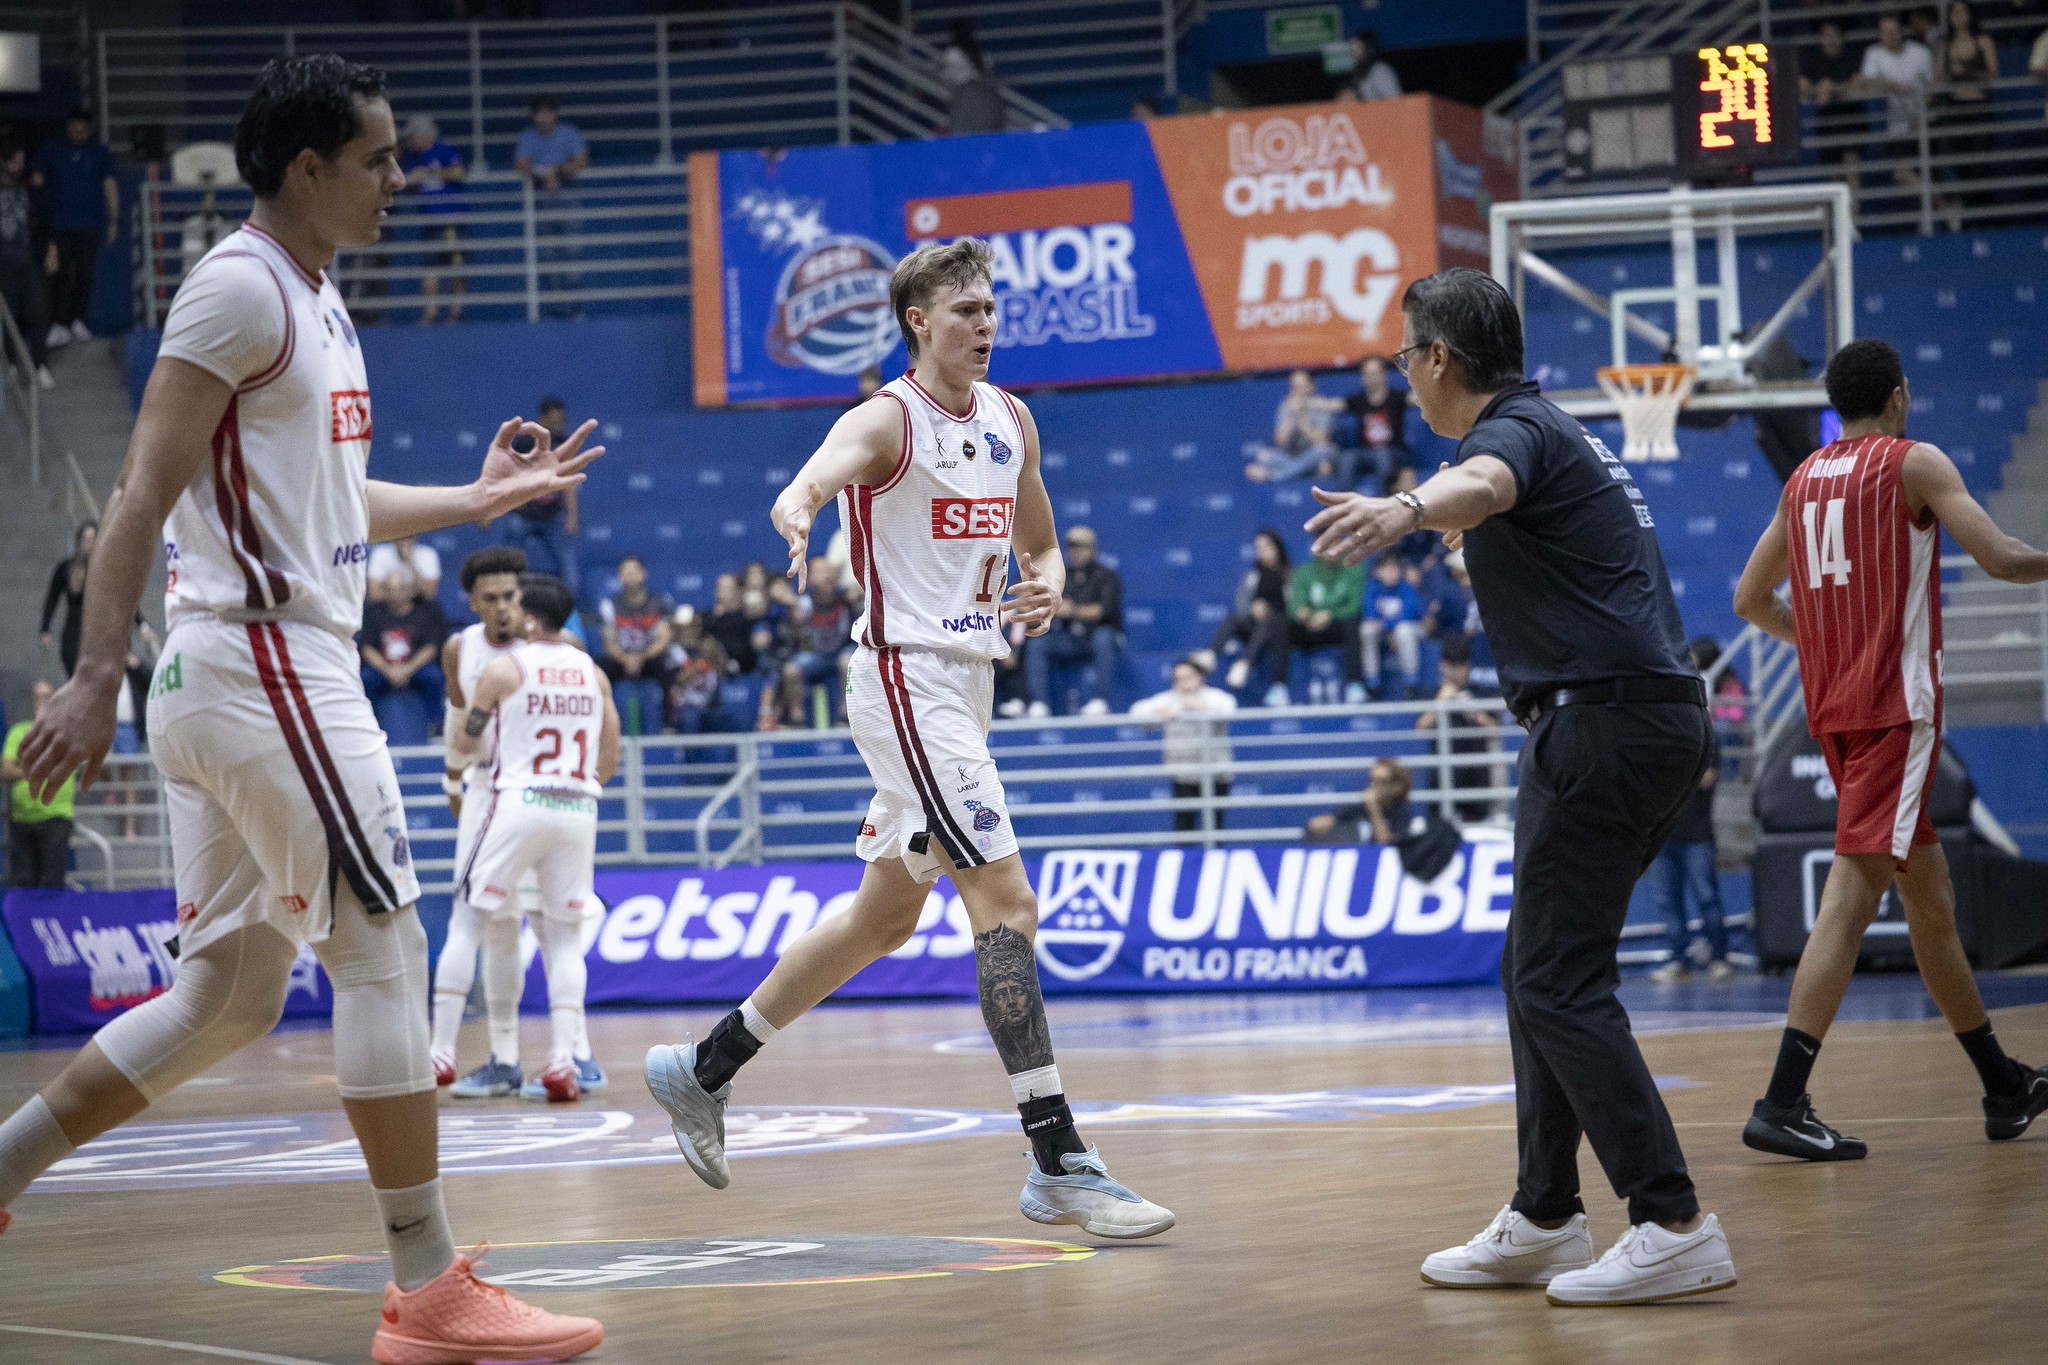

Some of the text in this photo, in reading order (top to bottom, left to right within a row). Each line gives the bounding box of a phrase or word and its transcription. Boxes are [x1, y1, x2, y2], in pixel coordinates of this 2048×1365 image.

[1228, 112, 1368, 174] LOJA
[1223, 163, 1396, 217] OFICIAL
[992, 279, 1157, 349] RASIL
[1236, 300, 1332, 330] SPORTS
[942, 503, 1011, 536] SESI
[1803, 498, 1852, 589] 14
[527, 693, 595, 716] PAROD
[533, 728, 587, 781] 21
[1143, 946, 1369, 981] POLO FRANCA
